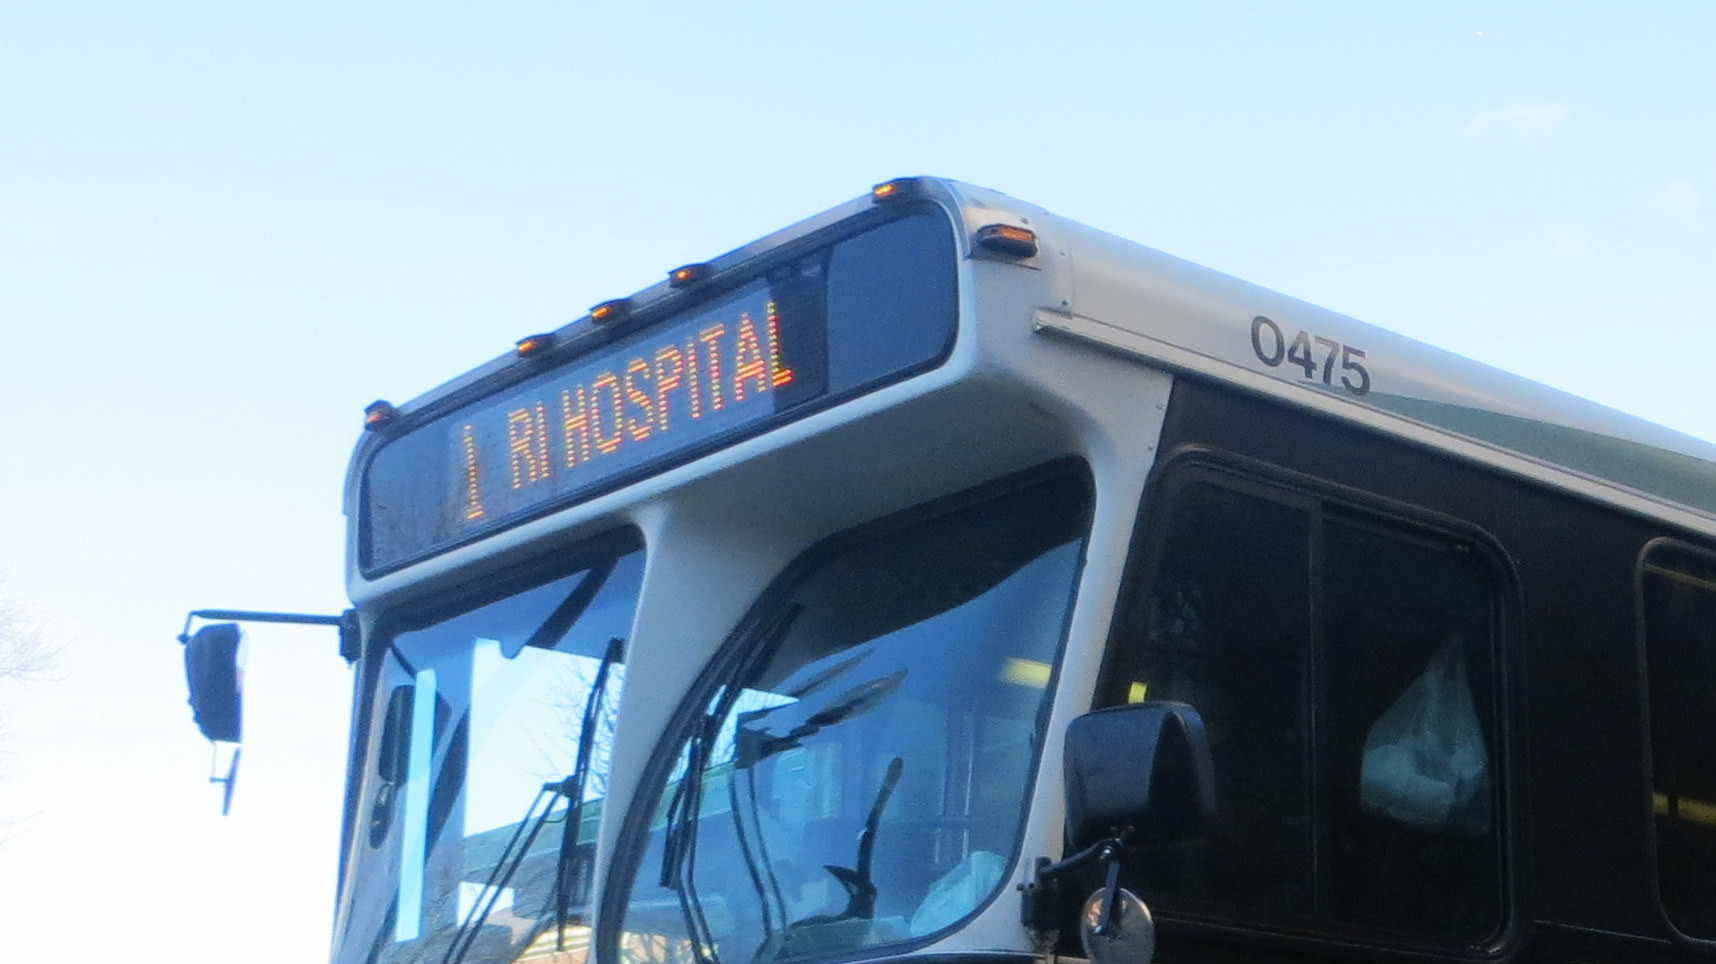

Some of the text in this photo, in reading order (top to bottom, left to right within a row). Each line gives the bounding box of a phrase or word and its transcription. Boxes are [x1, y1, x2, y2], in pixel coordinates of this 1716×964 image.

[463, 300, 795, 520] 1 RI HOSPITAL
[1251, 315, 1371, 396] 0475
